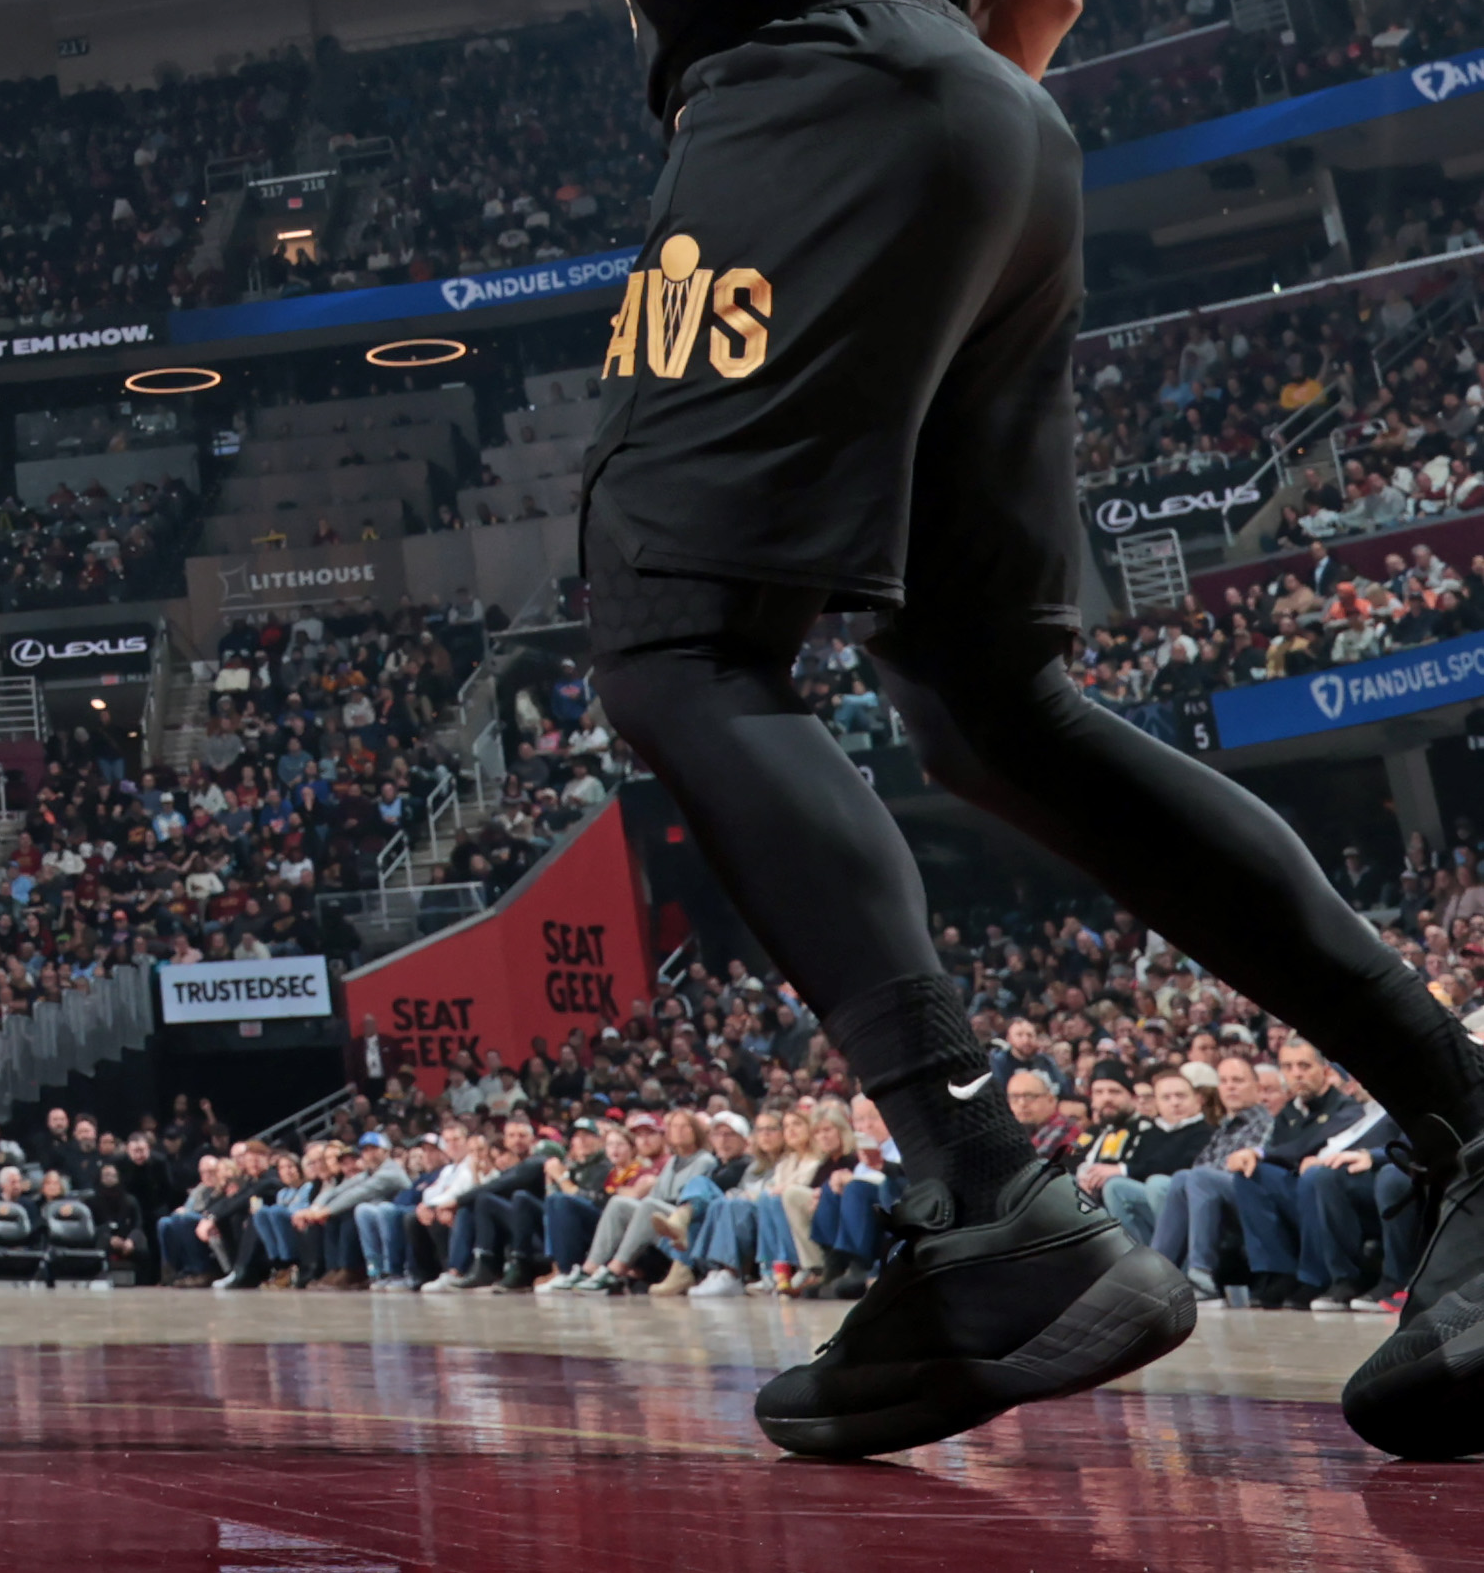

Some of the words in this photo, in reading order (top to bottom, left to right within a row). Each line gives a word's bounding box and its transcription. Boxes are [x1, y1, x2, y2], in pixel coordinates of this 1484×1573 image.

[12, 334, 55, 356] EM
[58, 323, 155, 352] KNOW.
[1139, 484, 1261, 521] LEXUS
[249, 563, 375, 591] LITEHOUSE
[47, 635, 148, 659] LEXUS
[1348, 659, 1449, 706] FANDUEL
[1193, 723, 1210, 751] 5
[541, 919, 605, 967] SEAT
[172, 973, 317, 1005] TRUSTEDSEC
[544, 970, 620, 1018] GEEK
[391, 997, 475, 1032] SEAT
